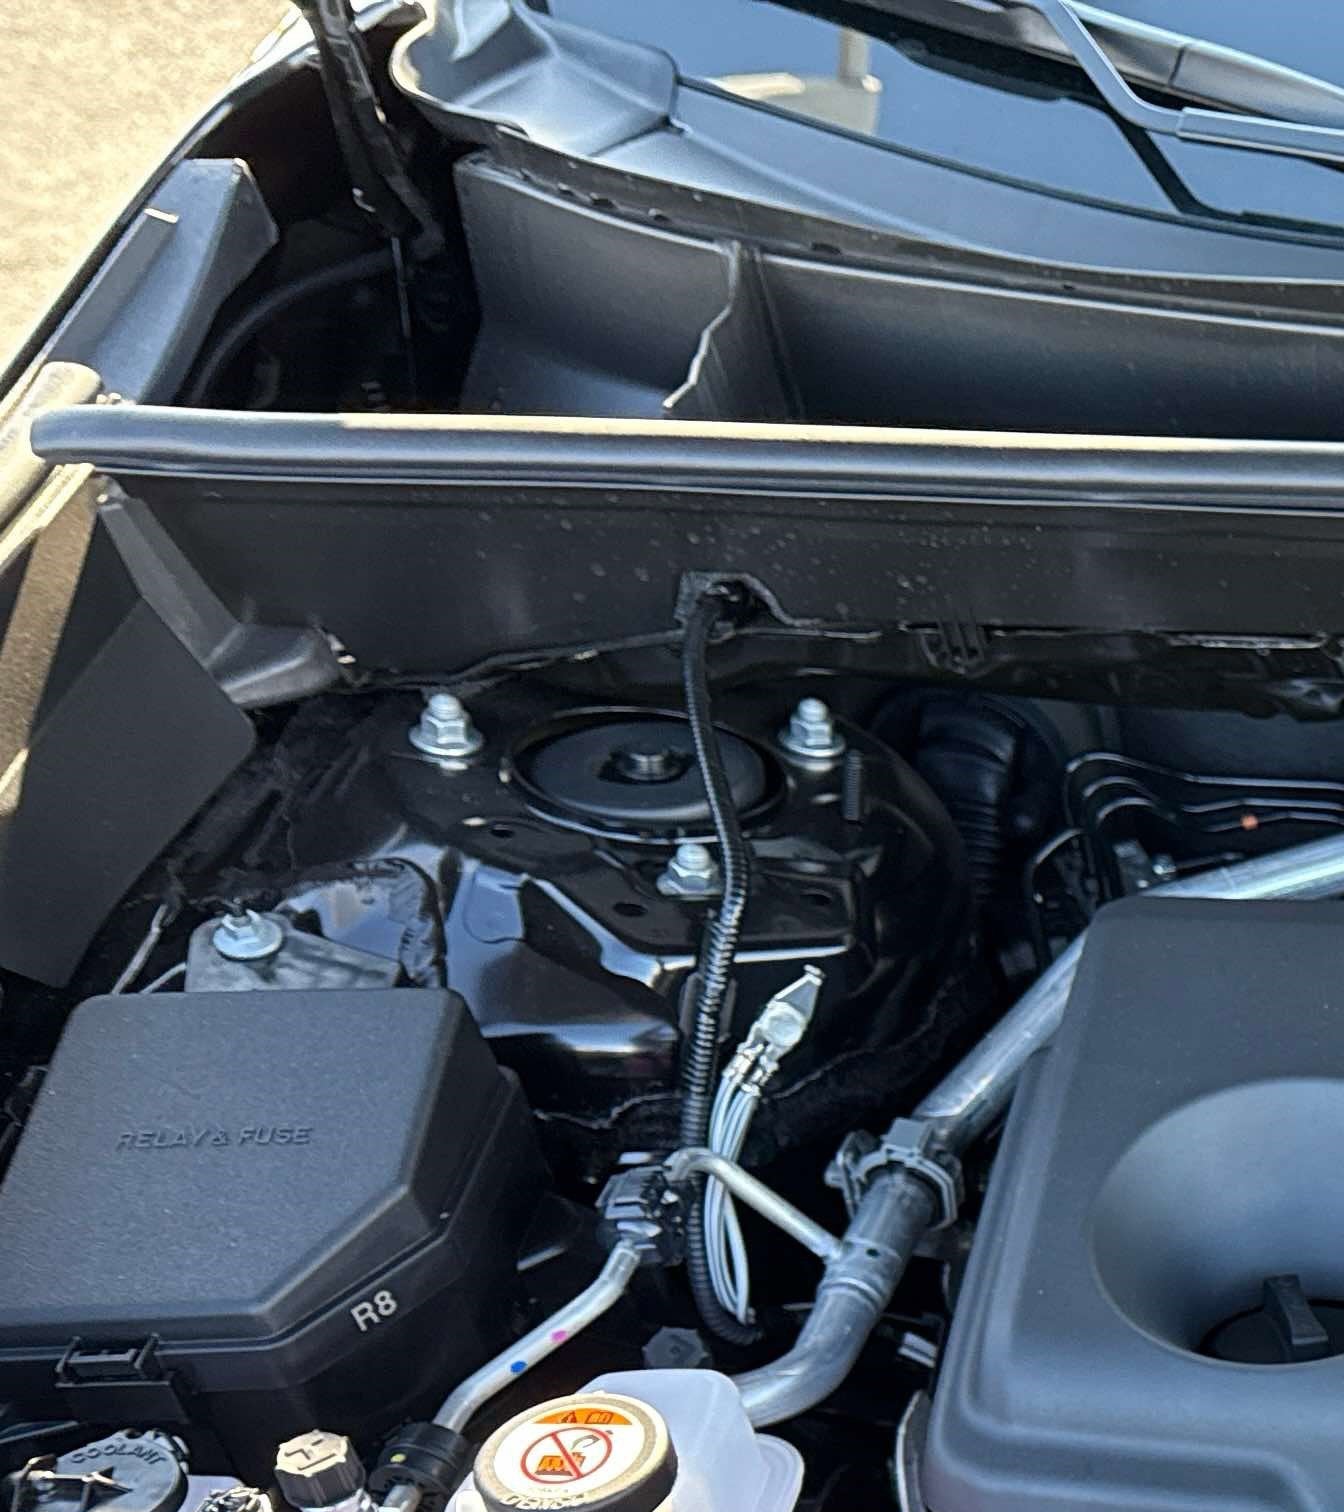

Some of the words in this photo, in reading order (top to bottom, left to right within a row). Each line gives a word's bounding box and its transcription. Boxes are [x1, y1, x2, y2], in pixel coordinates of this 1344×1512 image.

[115, 1129, 208, 1153] RELAY
[239, 1126, 314, 1145] FUSE
[350, 1290, 398, 1332] R8
[70, 1442, 168, 1466] COOLANT
